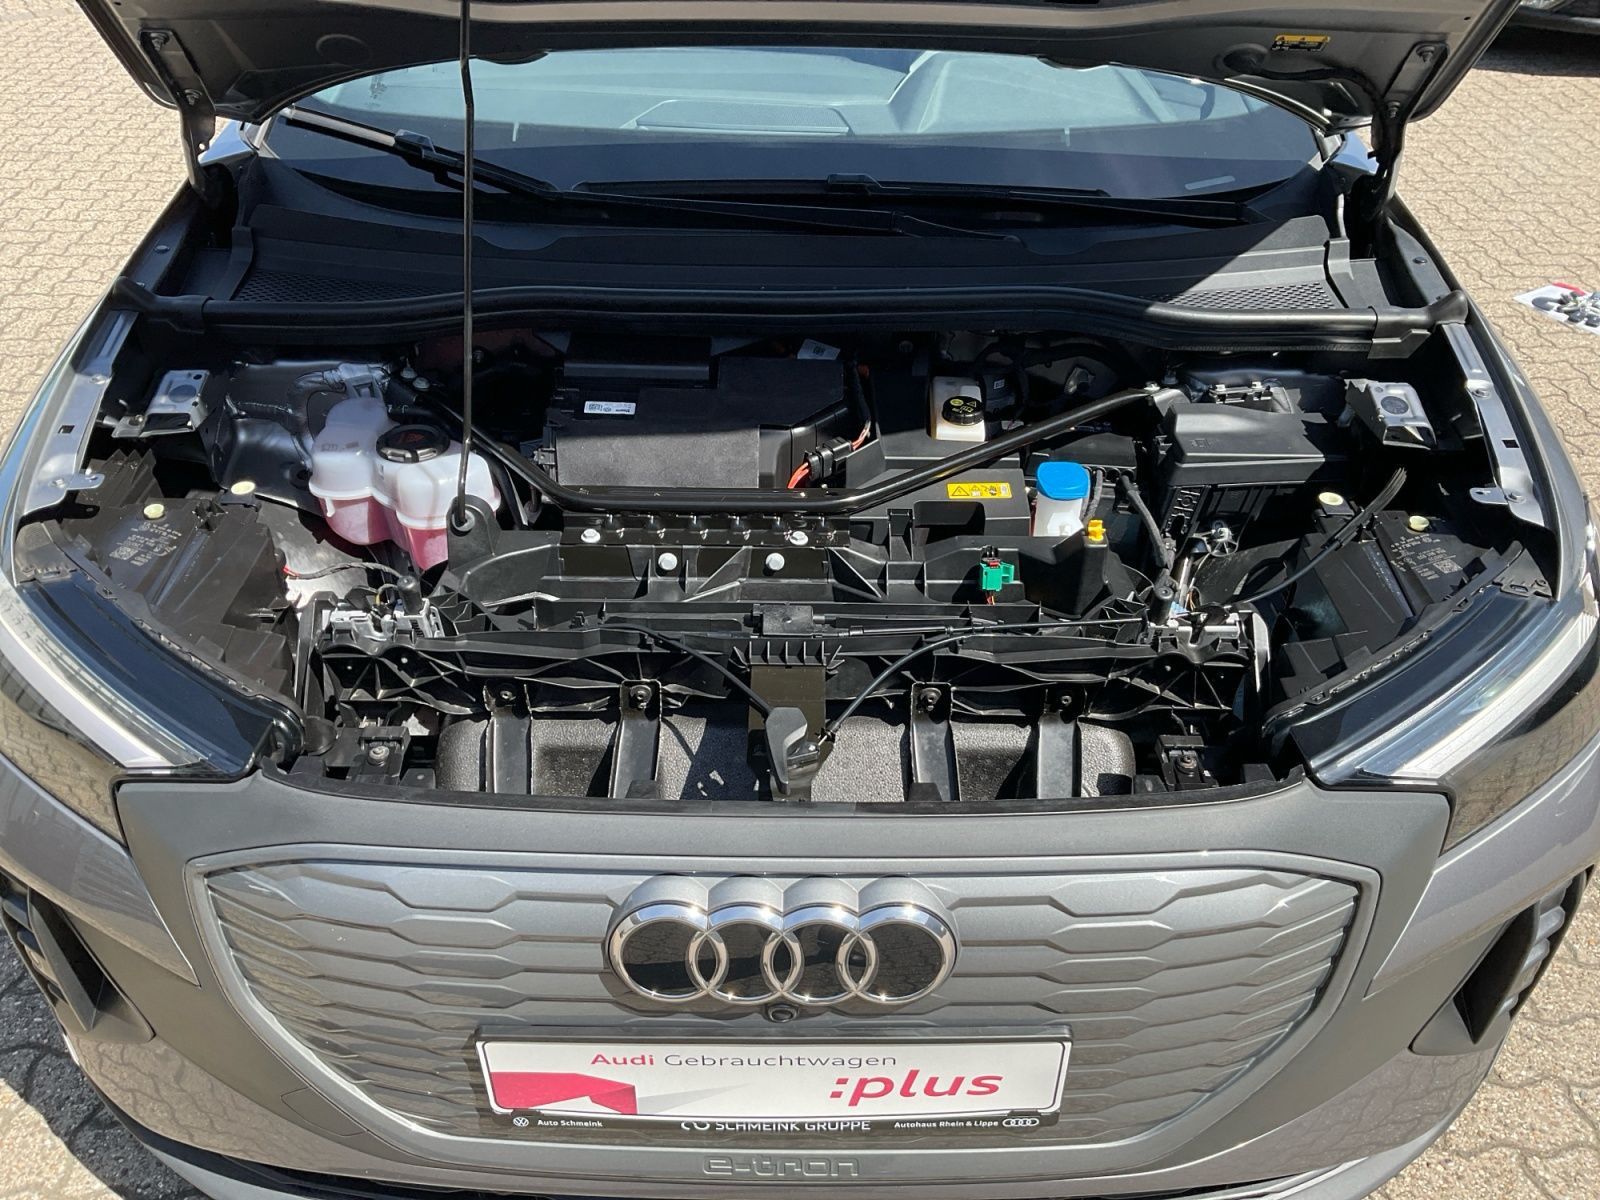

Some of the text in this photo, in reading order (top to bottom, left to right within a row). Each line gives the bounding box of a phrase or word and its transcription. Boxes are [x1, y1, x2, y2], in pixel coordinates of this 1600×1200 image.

[591, 1053, 897, 1069] Audi Gebrauchtwagen
[537, 1119, 603, 1128] Auto Schmeink
[804, 1120, 871, 1131] GRUPPE
[894, 1121, 937, 1129] Autohaus
[939, 1120, 964, 1128] Rhein
[974, 1119, 999, 1129] Lippe
[703, 1155, 860, 1177] e-tron
